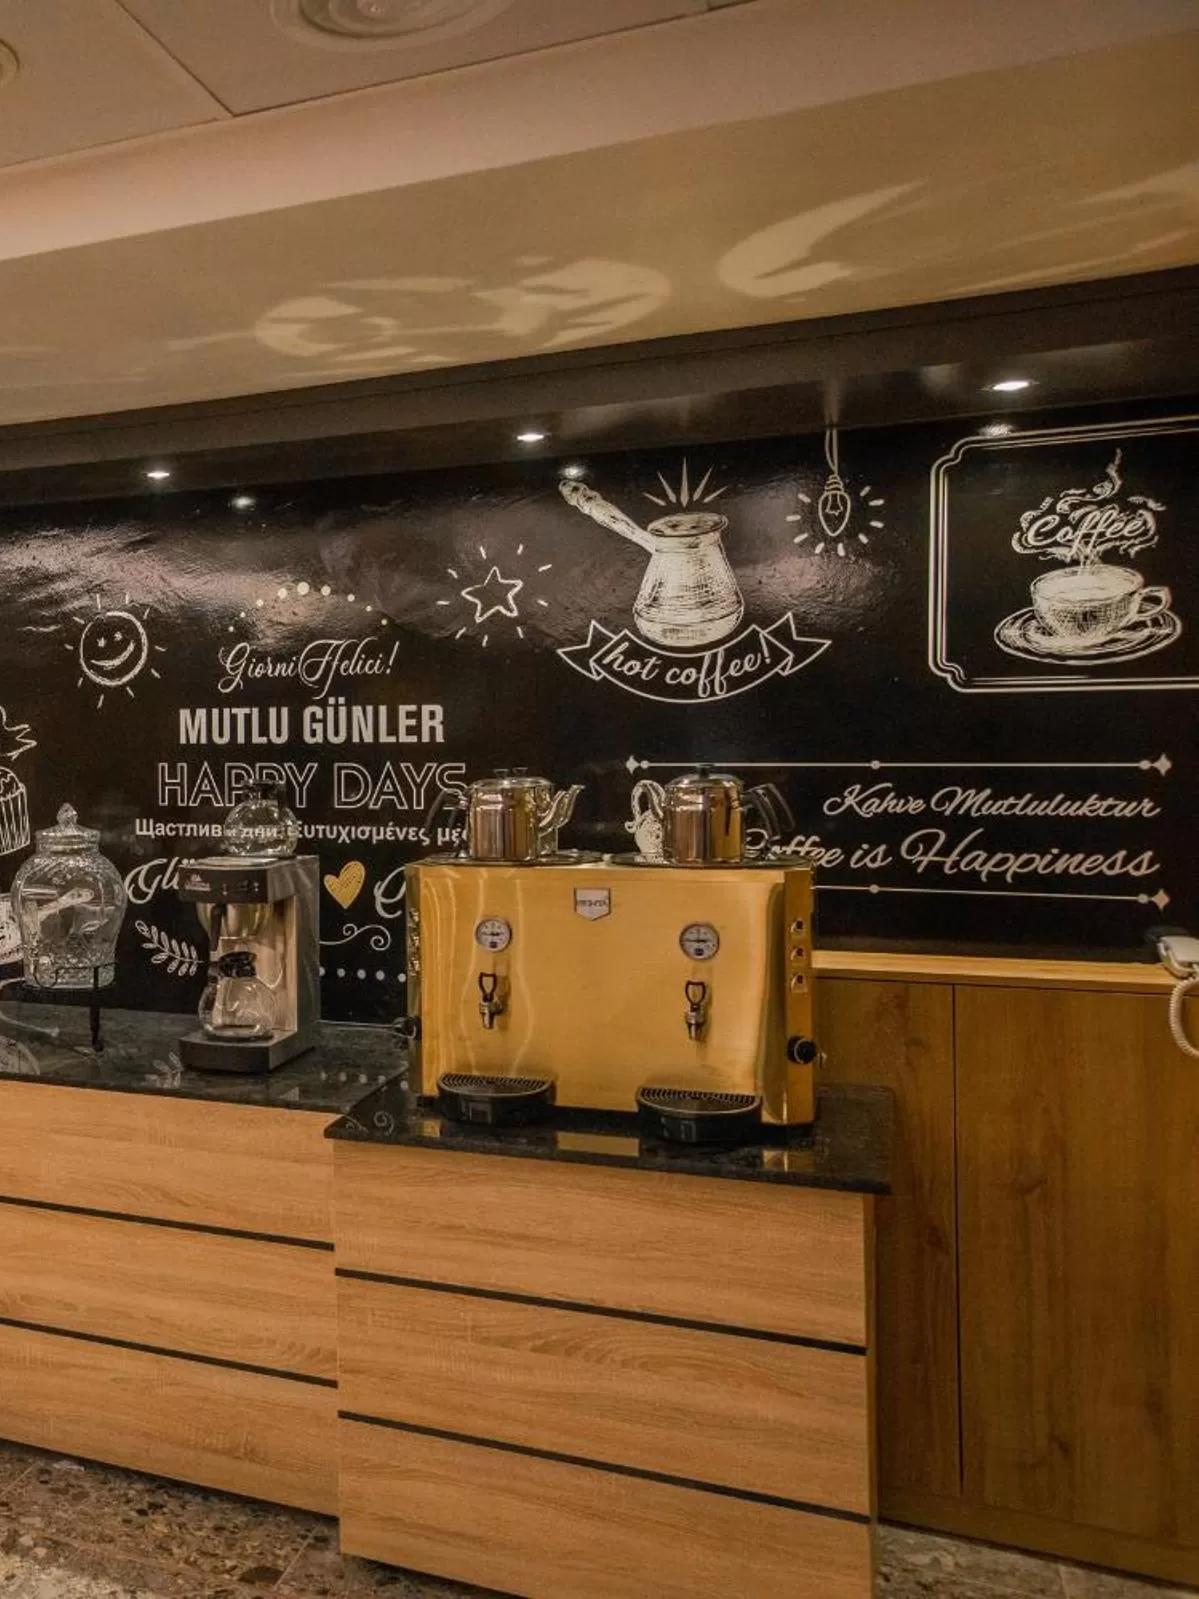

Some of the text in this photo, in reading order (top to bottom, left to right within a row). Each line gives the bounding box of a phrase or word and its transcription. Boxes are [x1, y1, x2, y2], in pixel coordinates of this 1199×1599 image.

[1026, 503, 1147, 556] Coffee
[217, 641, 298, 693] Giorni
[602, 633, 771, 698] hot coffee!
[178, 697, 445, 745] MUTLU GÜNLER
[333, 761, 468, 811] DAYS
[822, 782, 1162, 819] Kahve Mutluluktur
[850, 843, 893, 870] is
[900, 827, 1161, 884] Happiness
